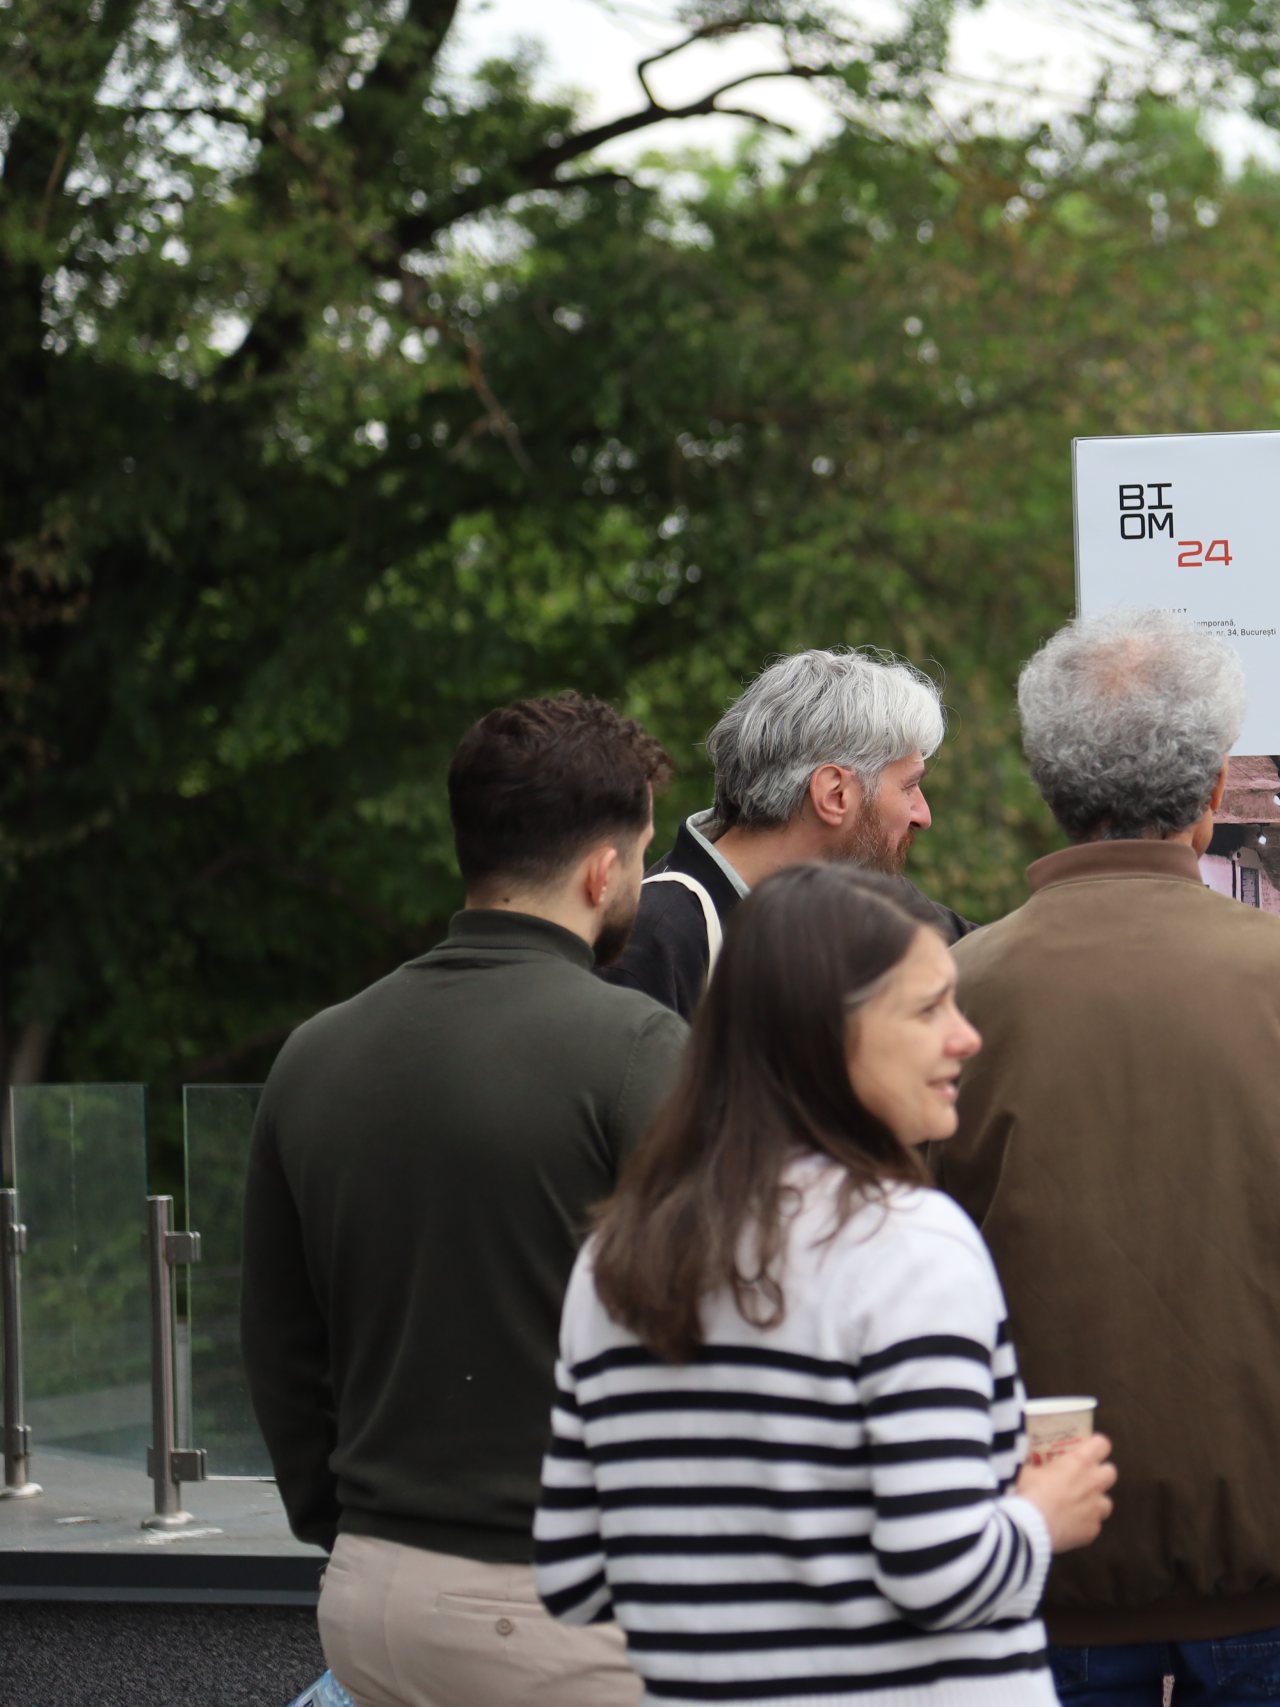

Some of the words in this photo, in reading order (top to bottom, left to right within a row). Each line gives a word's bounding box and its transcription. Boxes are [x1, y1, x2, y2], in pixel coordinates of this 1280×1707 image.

[1119, 483, 1172, 510] BI
[1120, 512, 1174, 539] OM
[1177, 540, 1233, 567] 24
[1227, 629, 1239, 637] 34,
[1241, 628, 1276, 637] București
